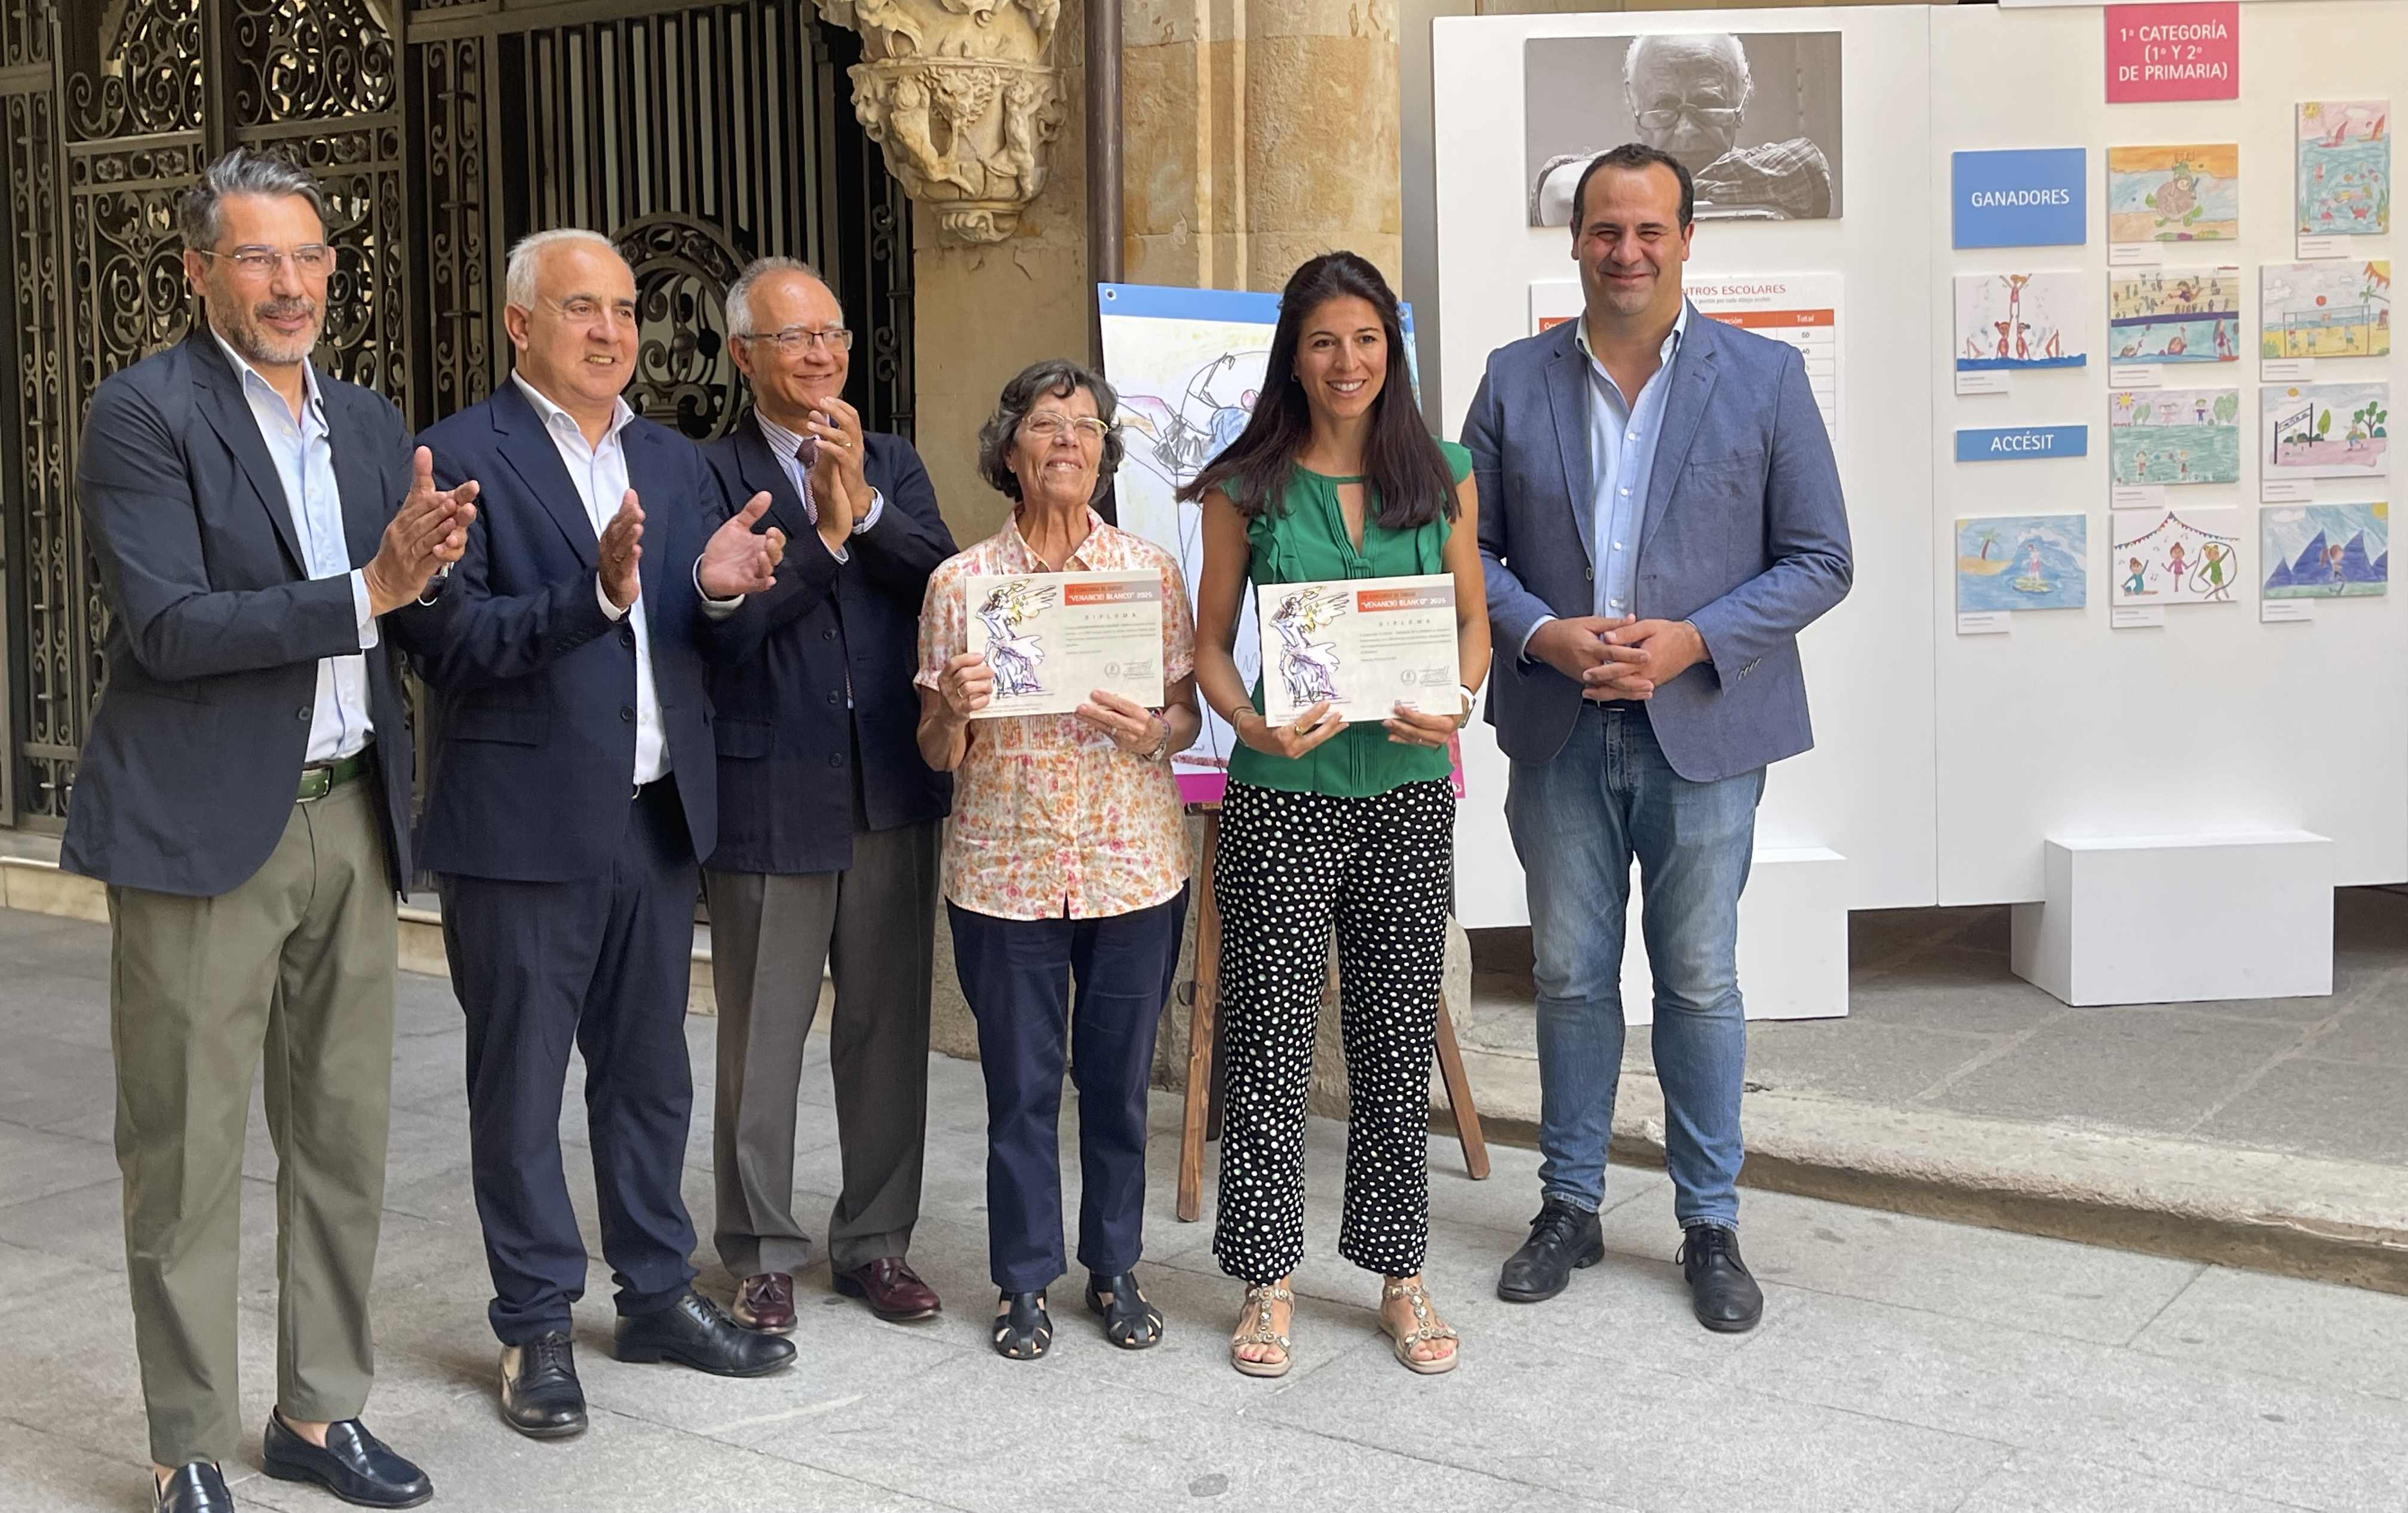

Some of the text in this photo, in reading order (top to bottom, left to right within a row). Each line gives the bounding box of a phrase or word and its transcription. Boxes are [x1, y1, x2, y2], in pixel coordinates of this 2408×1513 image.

[2139, 19, 2228, 41] CATEGORÍA
[2172, 45, 2182, 60] Y
[2187, 45, 2202, 60] 2º
[2120, 62, 2228, 81] DE PRIMARIA)
[1971, 189, 2069, 207] GANADORES
[1722, 284, 1786, 295] ESCOLARES
[1991, 431, 2054, 452] ACCÉSIT
[1106, 592, 1134, 600] BLANCO"
